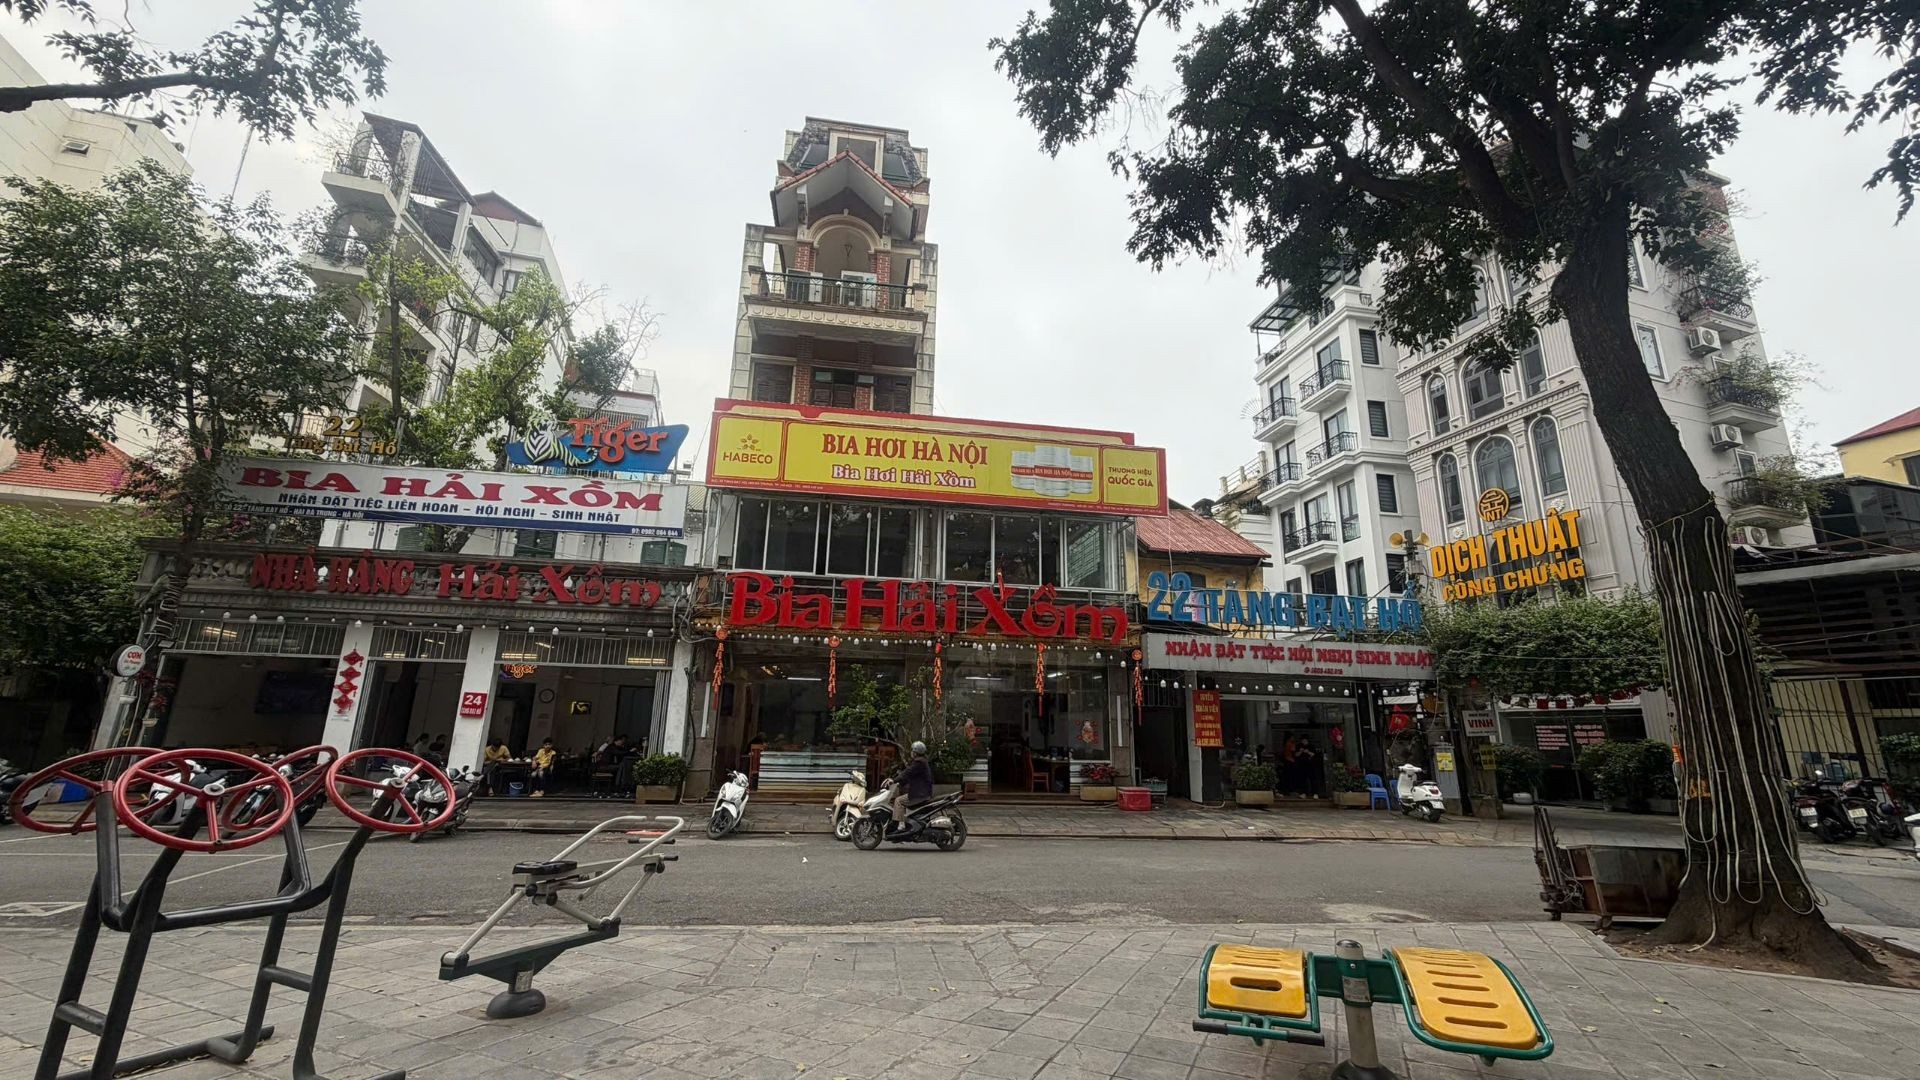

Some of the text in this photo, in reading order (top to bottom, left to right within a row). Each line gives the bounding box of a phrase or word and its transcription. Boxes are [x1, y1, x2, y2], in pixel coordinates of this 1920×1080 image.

[323, 416, 363, 437] 22
[569, 417, 668, 463] Tiger
[722, 451, 773, 465] HABECO
[821, 433, 989, 469] BIA HƠI HÀ NỘI
[237, 467, 664, 512] BIA HẢI XỒM
[832, 464, 976, 488] Bia Hơi Hải Xồm
[1108, 474, 1154, 487] QUỐC GIA
[278, 492, 317, 507] NHẬN
[322, 495, 349, 509] ĐẶT
[353, 497, 383, 510] TIỆC
[388, 499, 418, 511] LIÊN
[421, 502, 458, 514] HOAN
[476, 504, 499, 518] HỘI
[503, 507, 535, 520] NGHỊ
[552, 509, 583, 521] SINH
[588, 511, 621, 524] NHẬT
[1485, 510, 1502, 522] NT
[1430, 508, 1581, 580] DỊCH THUẬT
[251, 545, 662, 609] NHÀ HÀNG Hải Xồm
[1443, 558, 1585, 602] CÔNG CHỨNG
[726, 572, 1129, 645] Bia Hải Xồm
[1148, 571, 1421, 639] 22 TĂNG BẠT HỔ
[1165, 639, 1435, 669] NHẬN ĐẶT TIỆC HỘI NGHỊ SINH NHẬT
[464, 695, 482, 705] 24
[1468, 719, 1494, 728] VINH
